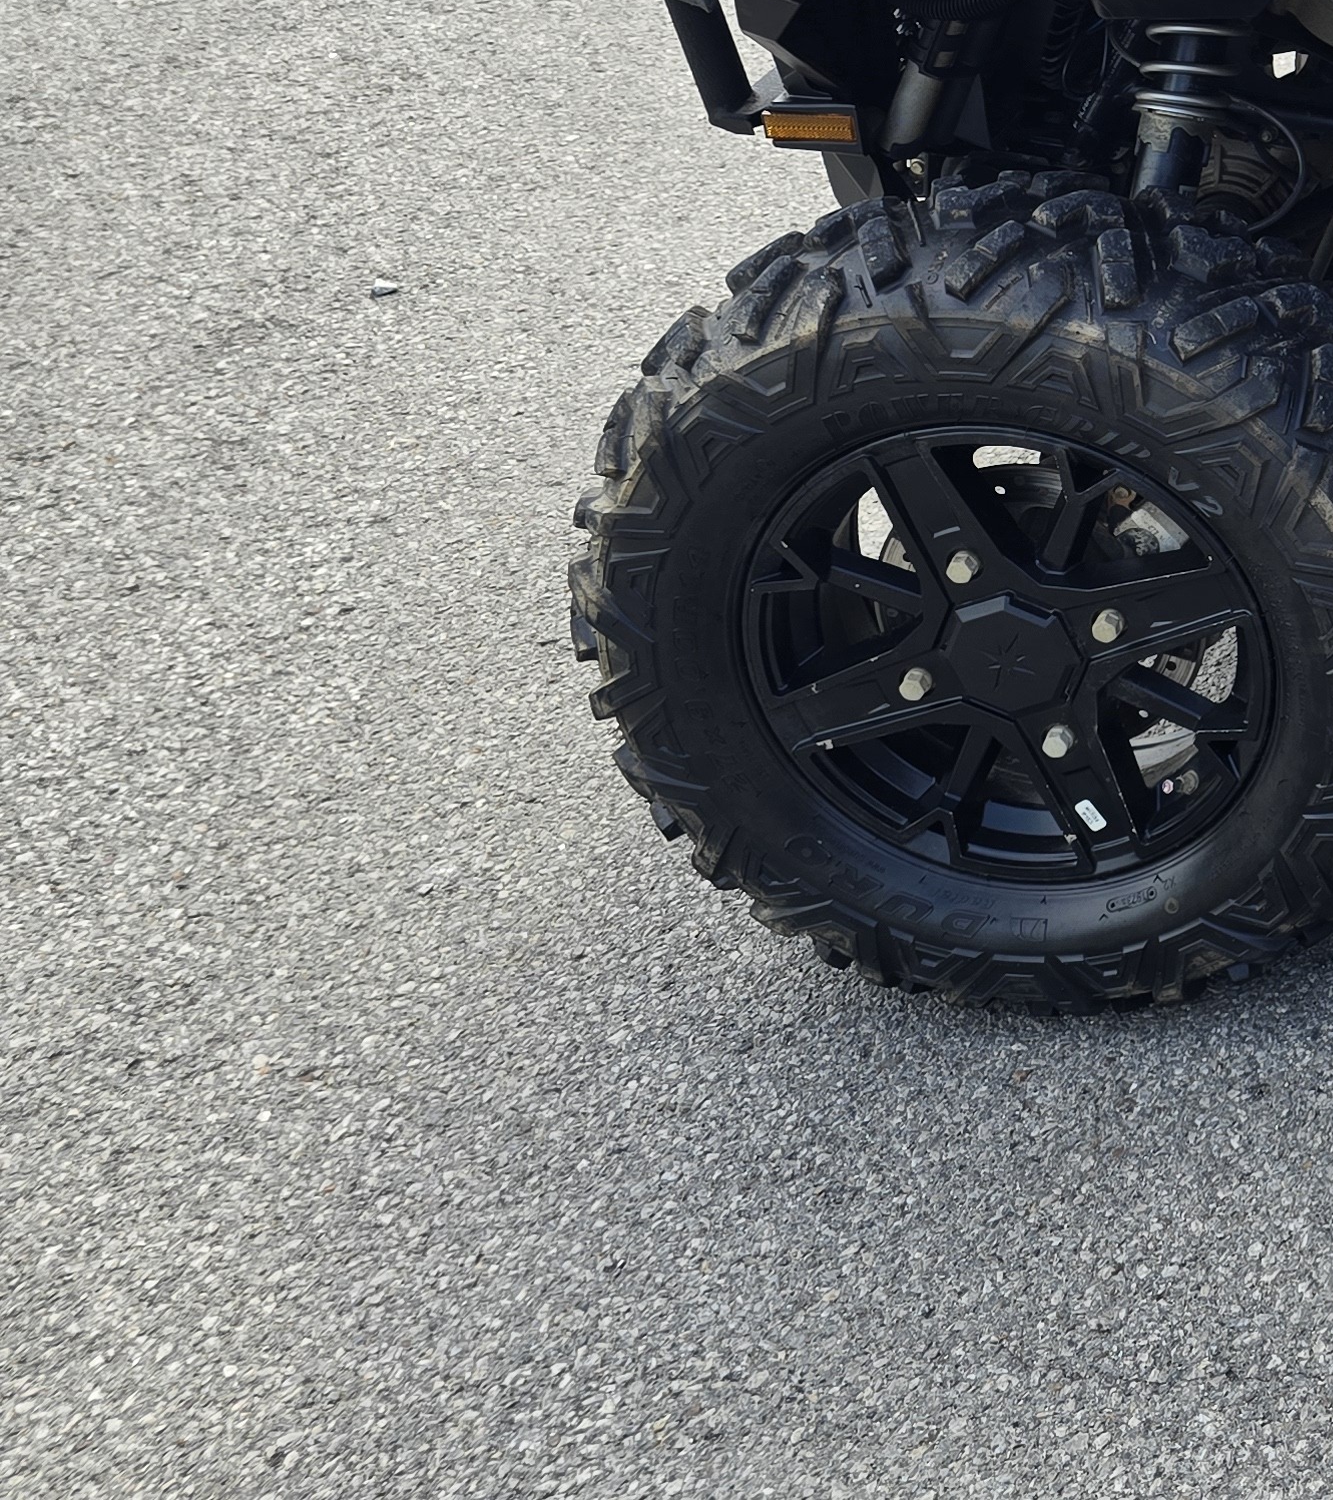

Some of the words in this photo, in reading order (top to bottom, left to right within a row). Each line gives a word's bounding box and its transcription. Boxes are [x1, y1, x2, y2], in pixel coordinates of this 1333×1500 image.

[1020, 404, 1153, 460] GRIP
[1167, 465, 1225, 518] V2
[783, 833, 991, 940] DURO
